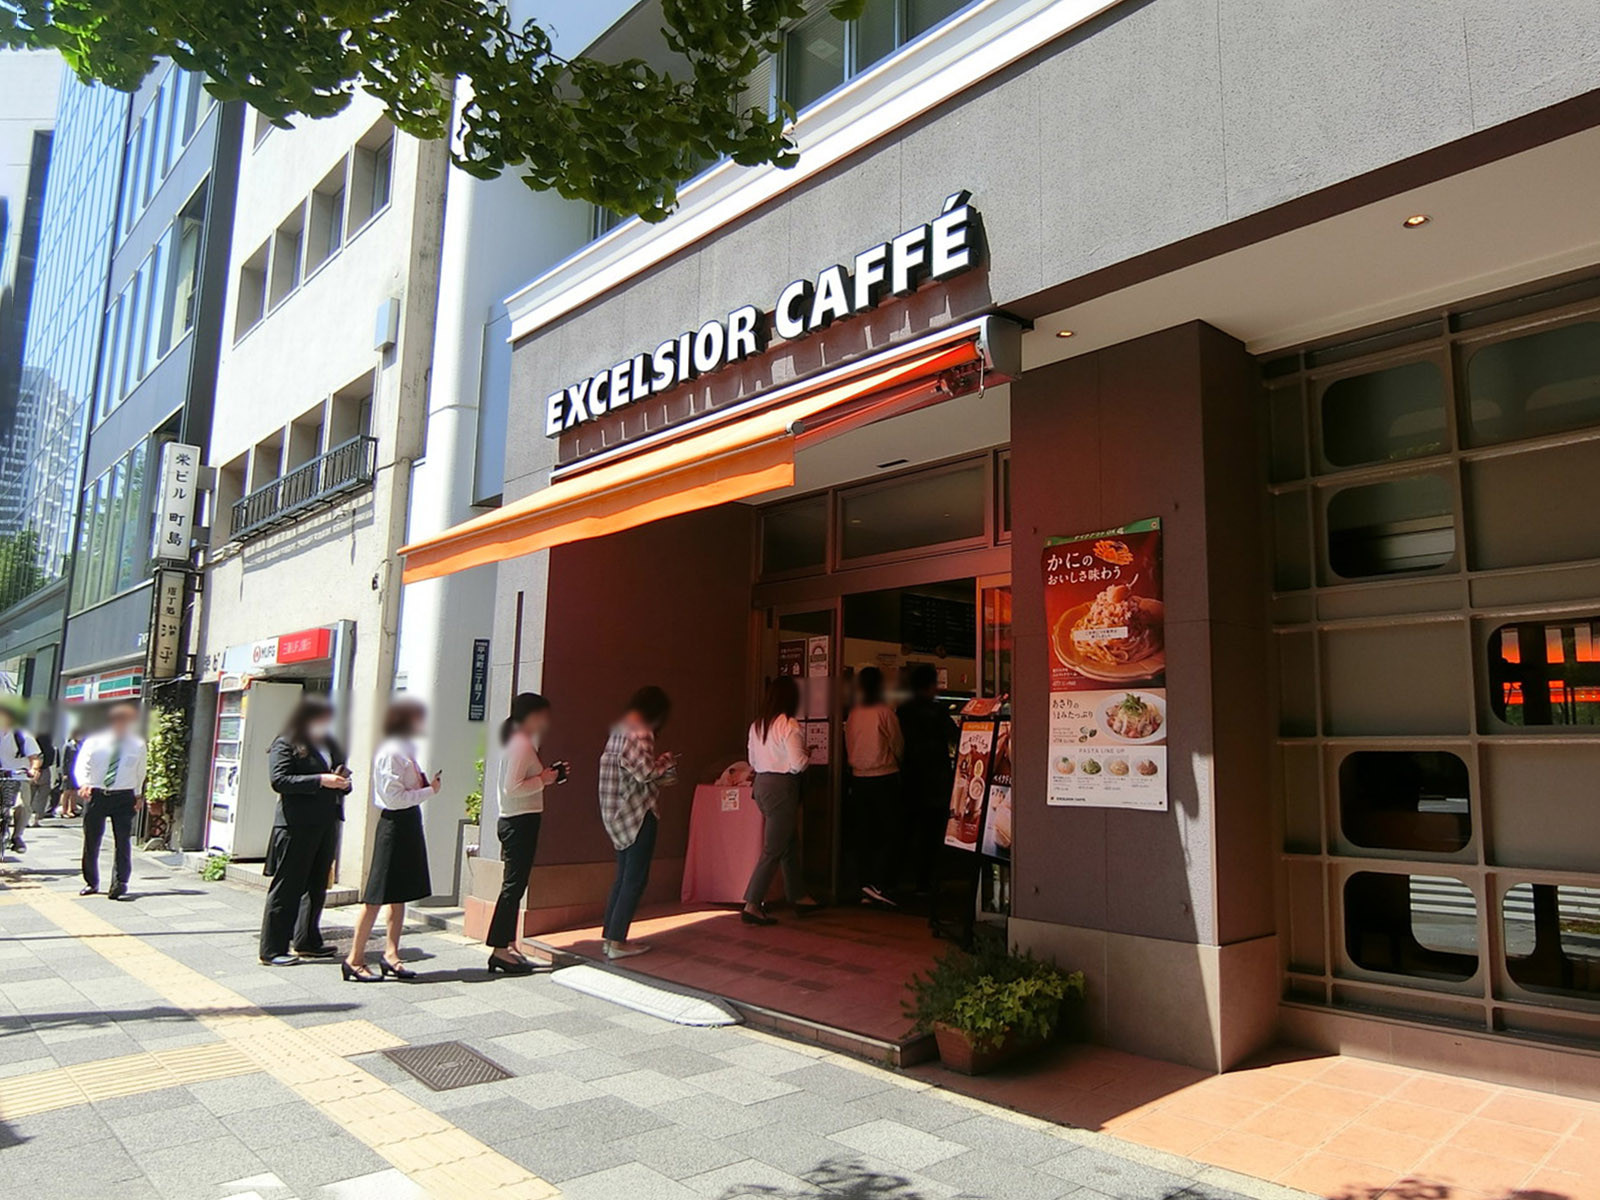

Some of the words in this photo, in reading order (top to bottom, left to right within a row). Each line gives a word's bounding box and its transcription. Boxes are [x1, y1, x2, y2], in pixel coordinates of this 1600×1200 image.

[545, 304, 761, 439] EXCELSIOR
[774, 189, 973, 341] CAFFÉ
[1047, 552, 1093, 571] かにの
[1048, 566, 1121, 585] おいしさ味わう
[261, 645, 276, 658] MUFG
[1052, 699, 1080, 709] あさりの
